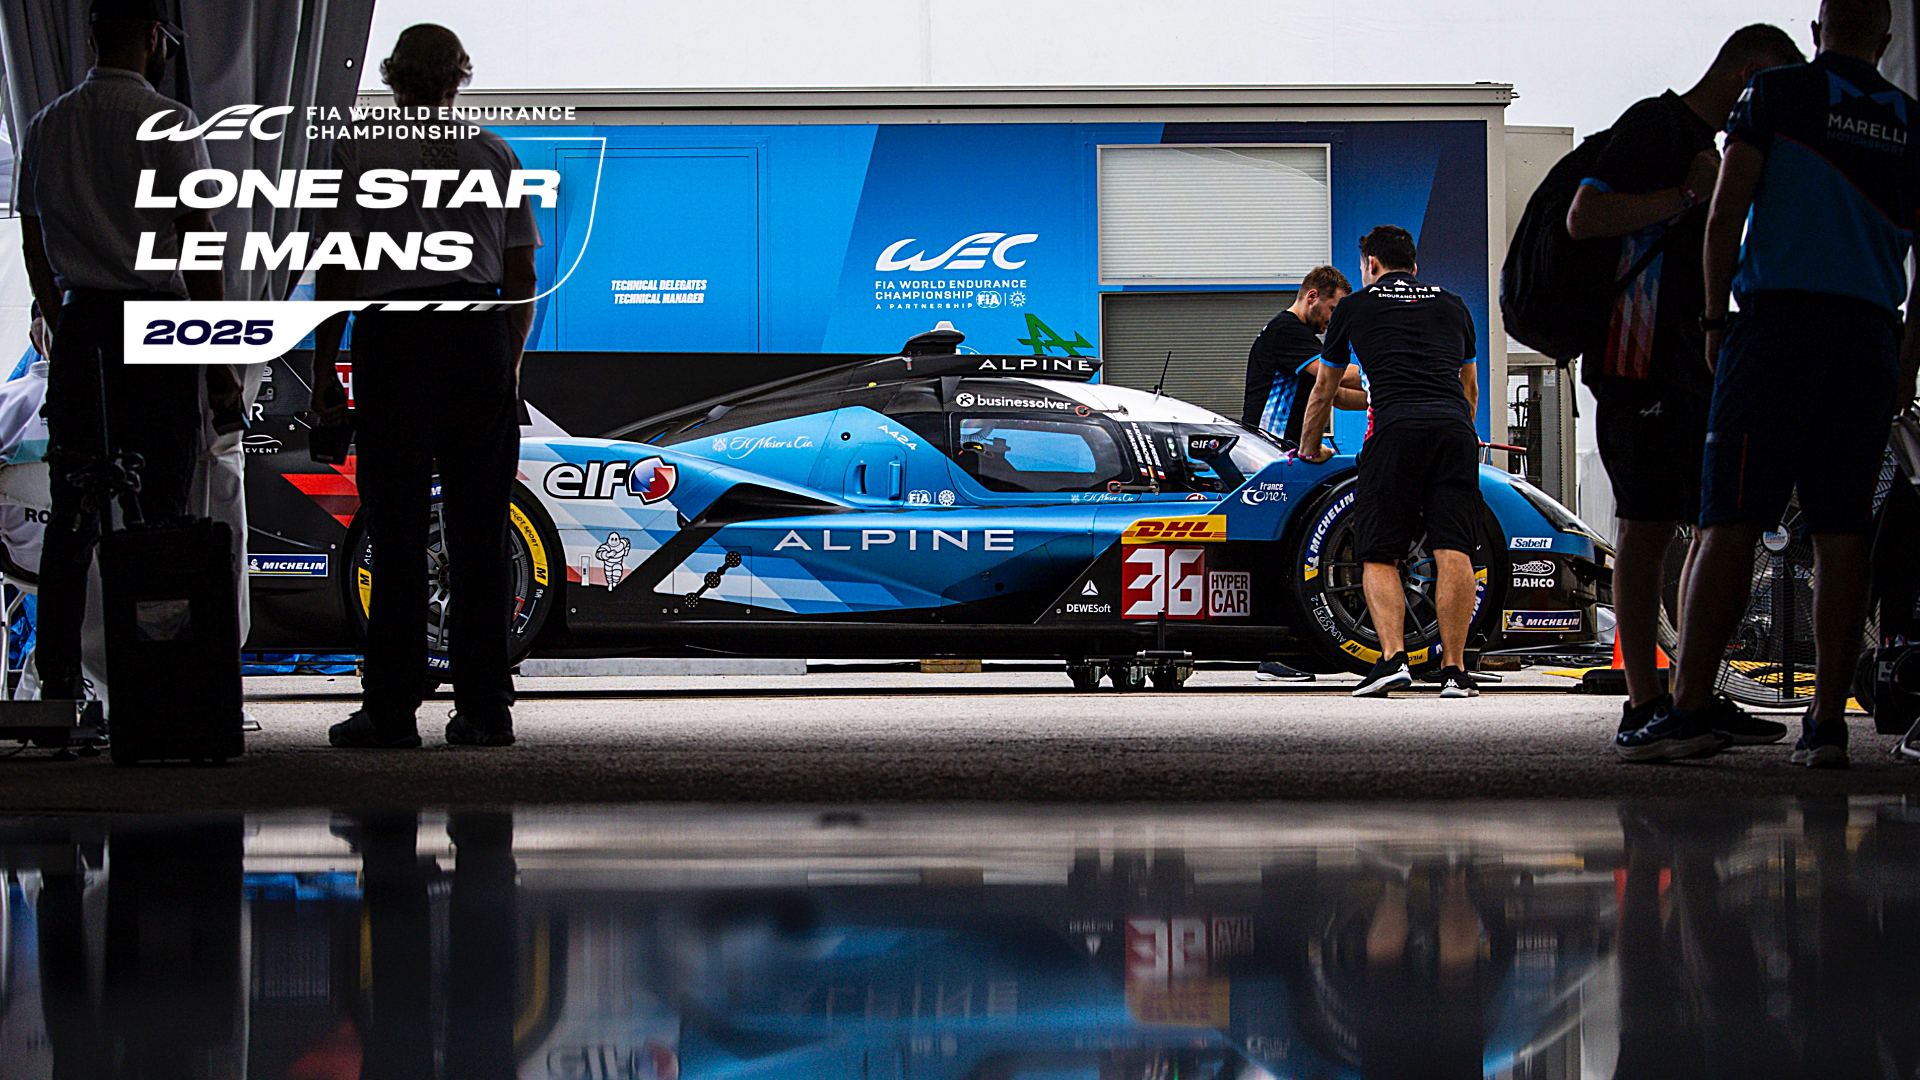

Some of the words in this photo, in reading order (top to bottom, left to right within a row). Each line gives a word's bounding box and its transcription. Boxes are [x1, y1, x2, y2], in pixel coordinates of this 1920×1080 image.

[1828, 112, 1908, 146] MARELLI
[1826, 130, 1907, 157] MOTORSPORT
[875, 232, 1039, 272] WEC
[611, 279, 658, 291] TECHNICAL
[658, 279, 708, 291] DELEGATES
[875, 280, 896, 290] FIA
[899, 280, 946, 290] WORLD
[949, 279, 1028, 289] ENDURANCE
[1368, 285, 1441, 294] ALPINE
[614, 293, 661, 305] TECHNICAL
[661, 293, 705, 304] MANAGER
[875, 290, 974, 301] CHAMPIONSHIP
[978, 358, 1094, 371] ALPINE
[977, 394, 1072, 410] businessolver
[878, 424, 918, 451] A424
[1190, 440, 1209, 449] elf
[544, 461, 629, 499] elf
[1260, 481, 1284, 491] France
[1135, 521, 1213, 538] DHL
[1309, 492, 1356, 554] MICHELIN
[523, 525, 539, 548] SPORT
[773, 529, 1015, 551] ALPINE
[1514, 538, 1548, 549] Sabelt
[261, 561, 326, 571] MICHELIN
[1123, 548, 1205, 616] 36
[1211, 574, 1249, 590] HYPER
[1513, 577, 1555, 588] BAHCO
[1066, 604, 1112, 613] DEWESoft
[1211, 590, 1249, 614] CAR
[1525, 618, 1580, 626] MICHELIN
